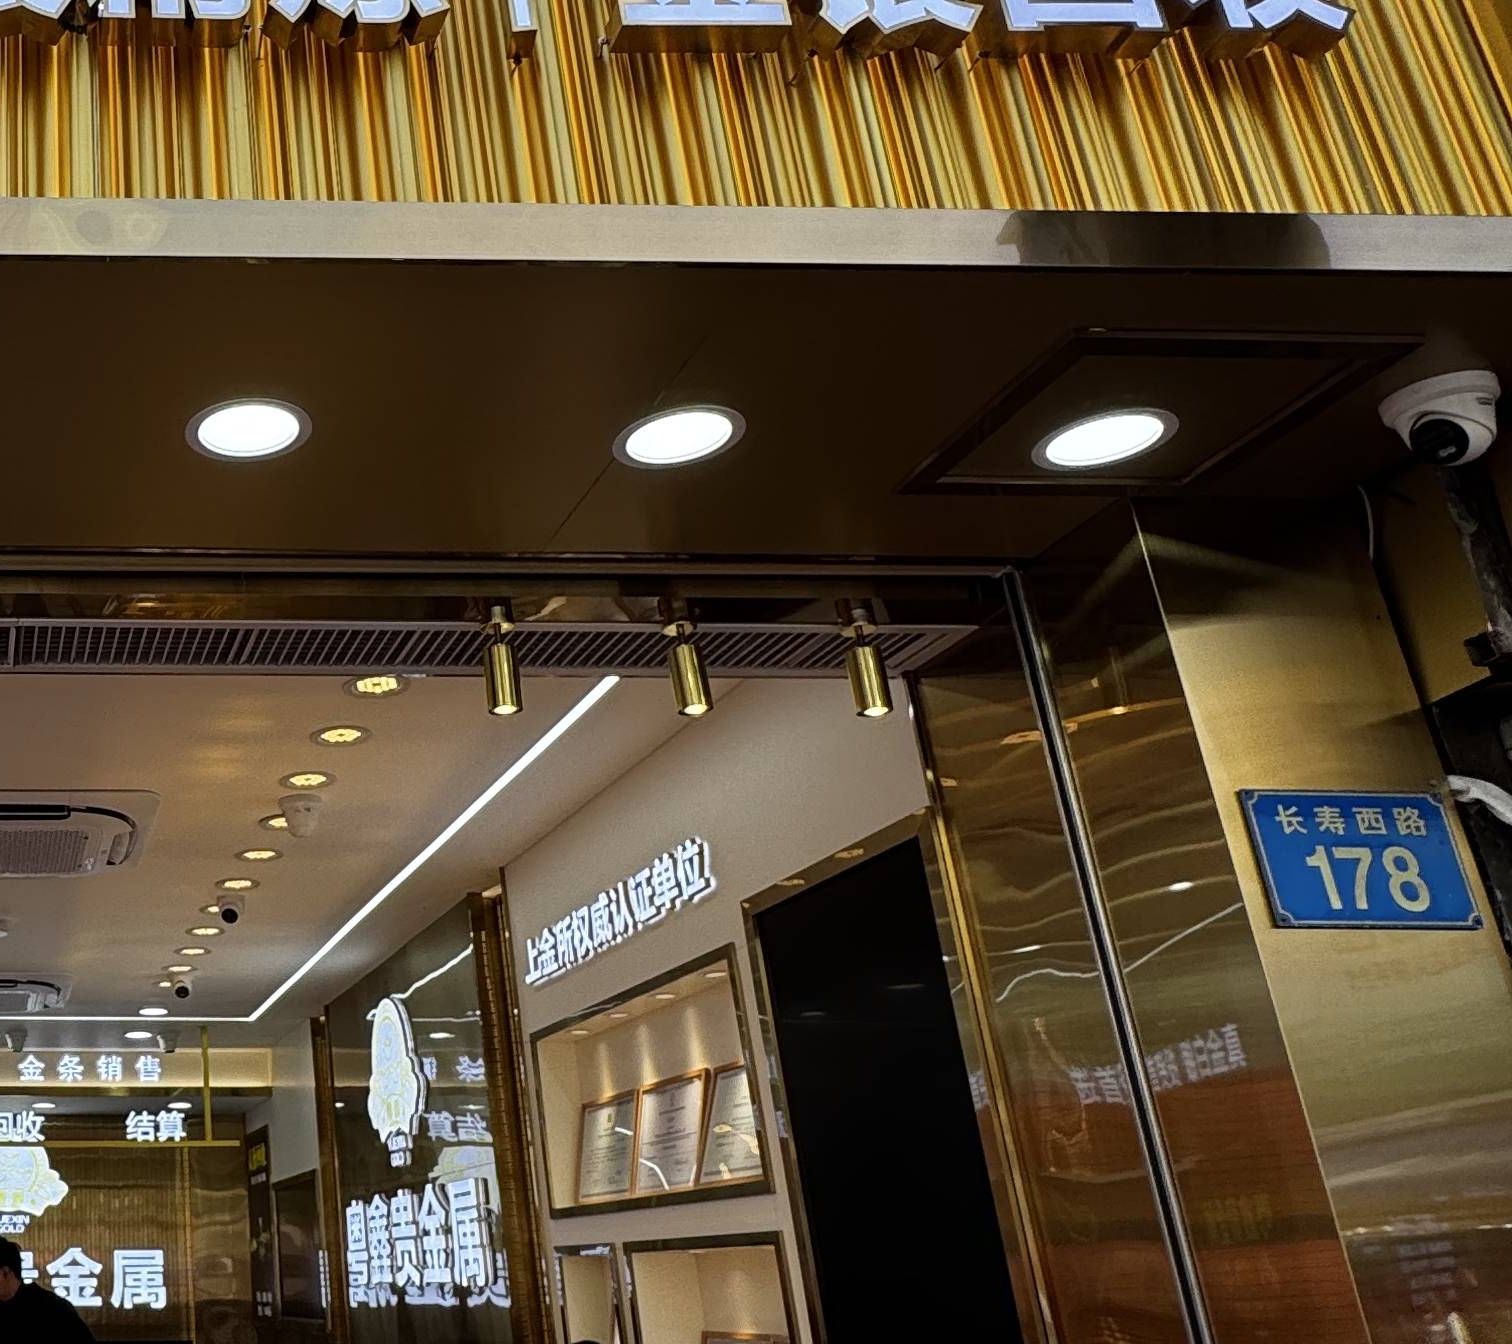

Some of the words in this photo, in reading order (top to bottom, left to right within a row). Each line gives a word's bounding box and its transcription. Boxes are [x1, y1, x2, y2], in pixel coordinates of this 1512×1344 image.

[1274, 804, 1428, 837] 长寿西路
[1304, 844, 1431, 913] 178
[18, 1053, 163, 1083] 金条销售
[124, 1110, 188, 1143] 结算
[345, 1177, 488, 1289] 粤鑫贵金属
